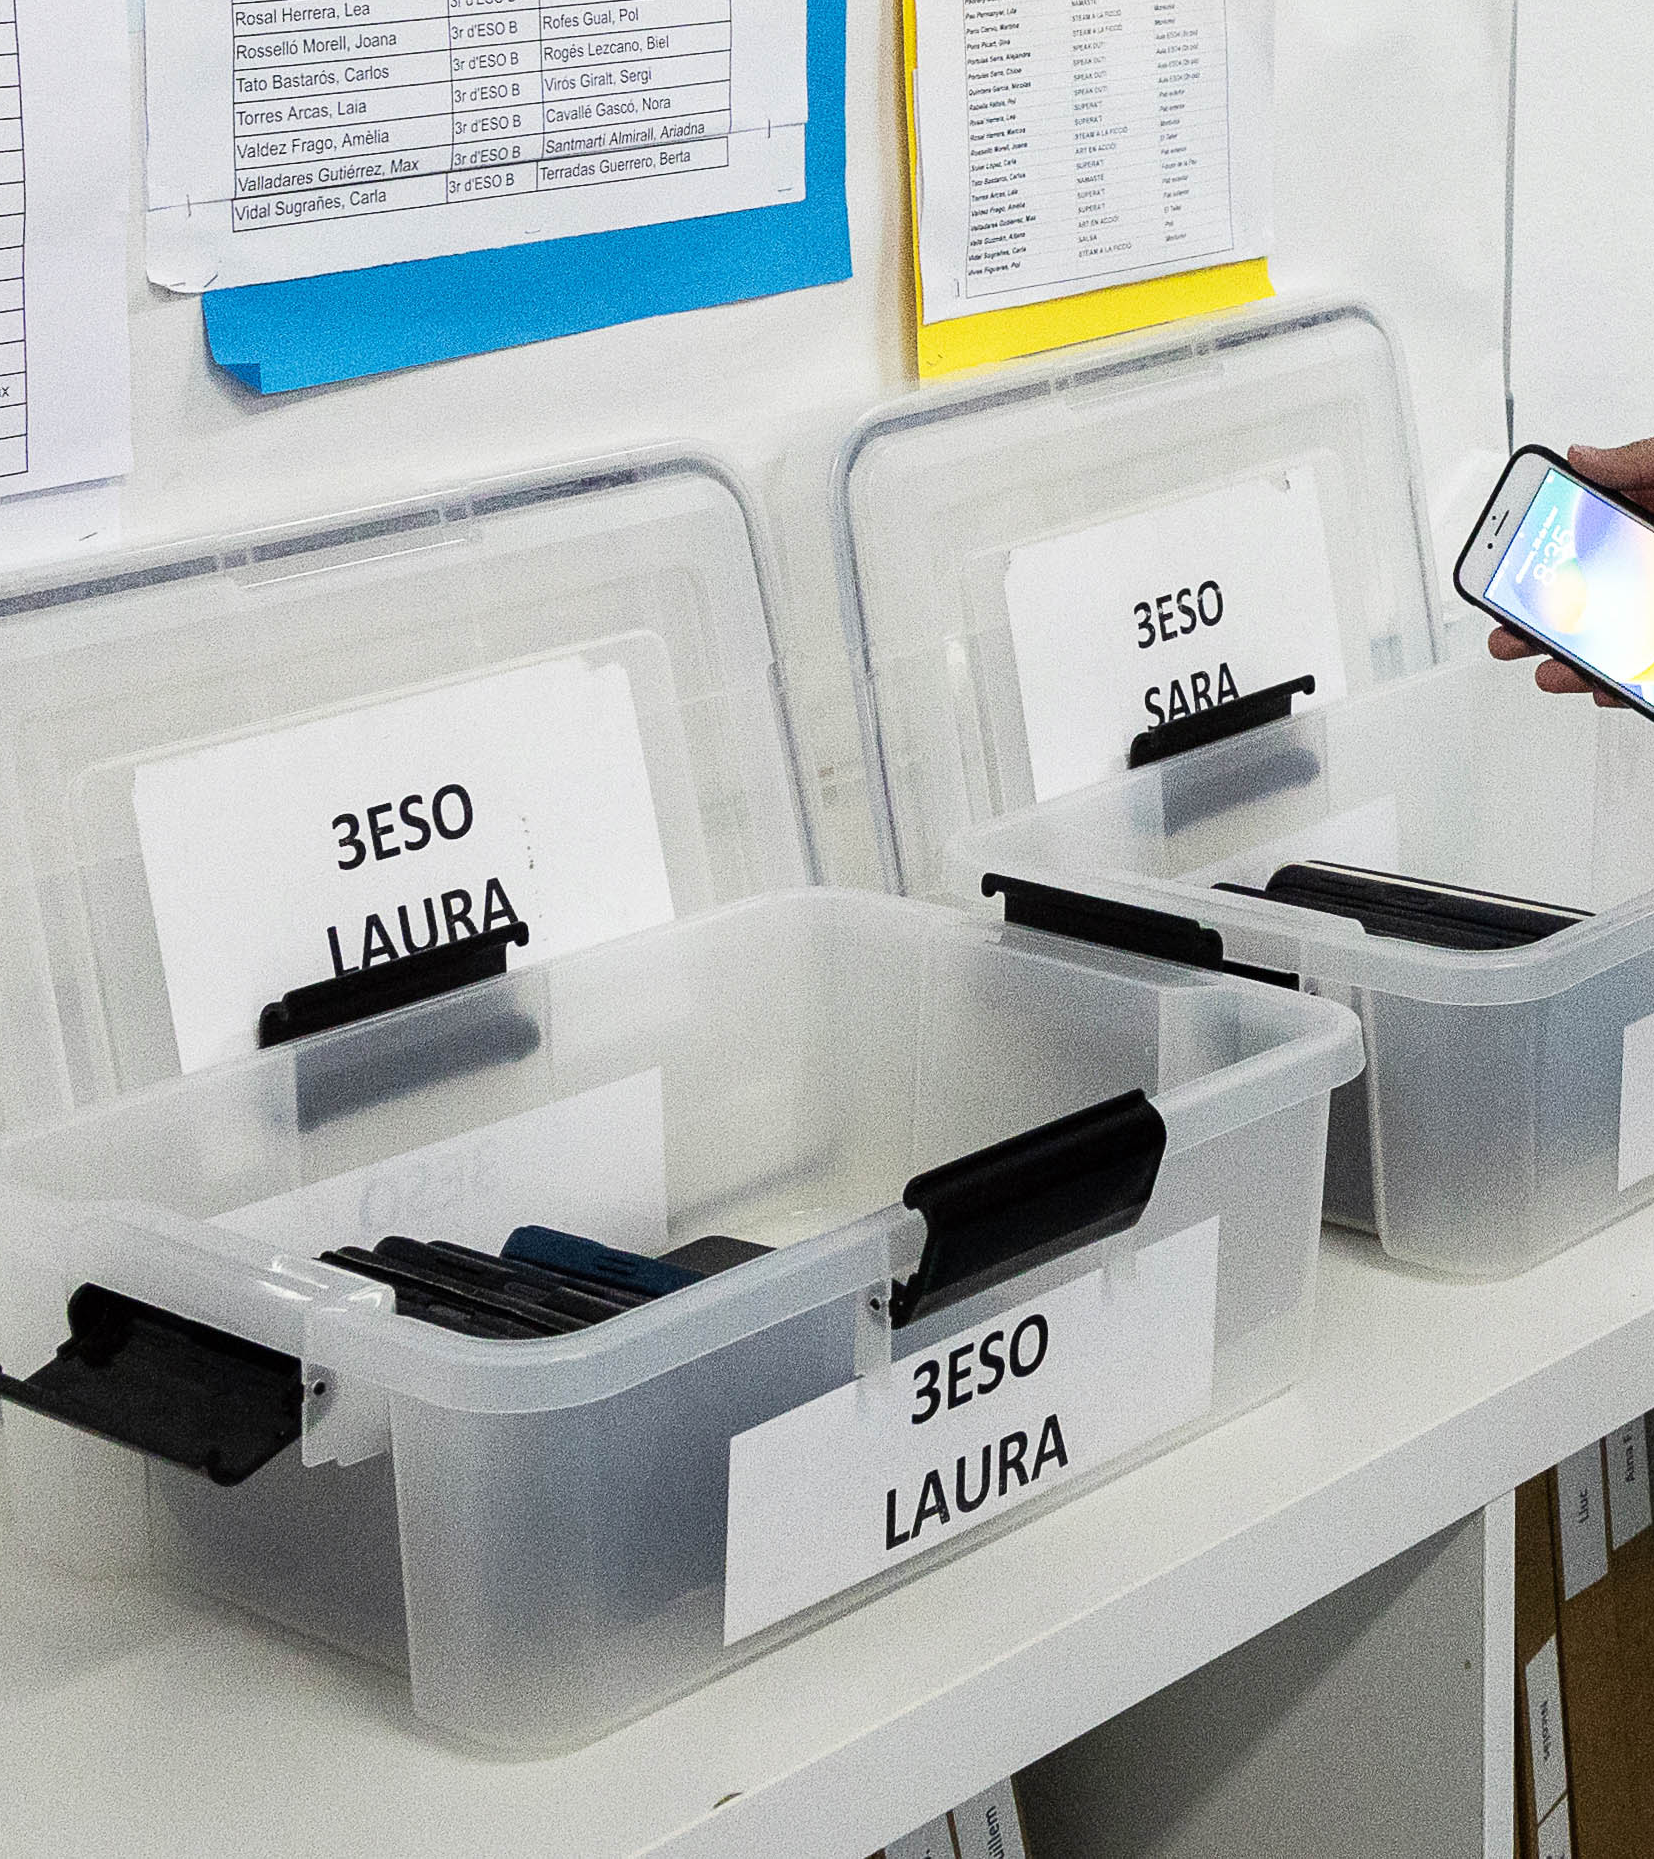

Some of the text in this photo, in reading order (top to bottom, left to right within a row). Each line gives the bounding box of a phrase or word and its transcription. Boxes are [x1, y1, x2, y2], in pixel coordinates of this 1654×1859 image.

[235, 189, 386, 221] Vidal Sugrañes, Carla
[539, 151, 691, 182] Terradas Guerrero, Berta
[1134, 580, 1223, 648] 3ESO
[1145, 662, 1241, 731] SARA
[332, 784, 473, 870] 3ESO
[327, 877, 519, 978] LAURA
[912, 1314, 1048, 1424] 3ESO
[886, 1413, 1068, 1550] LAURA
